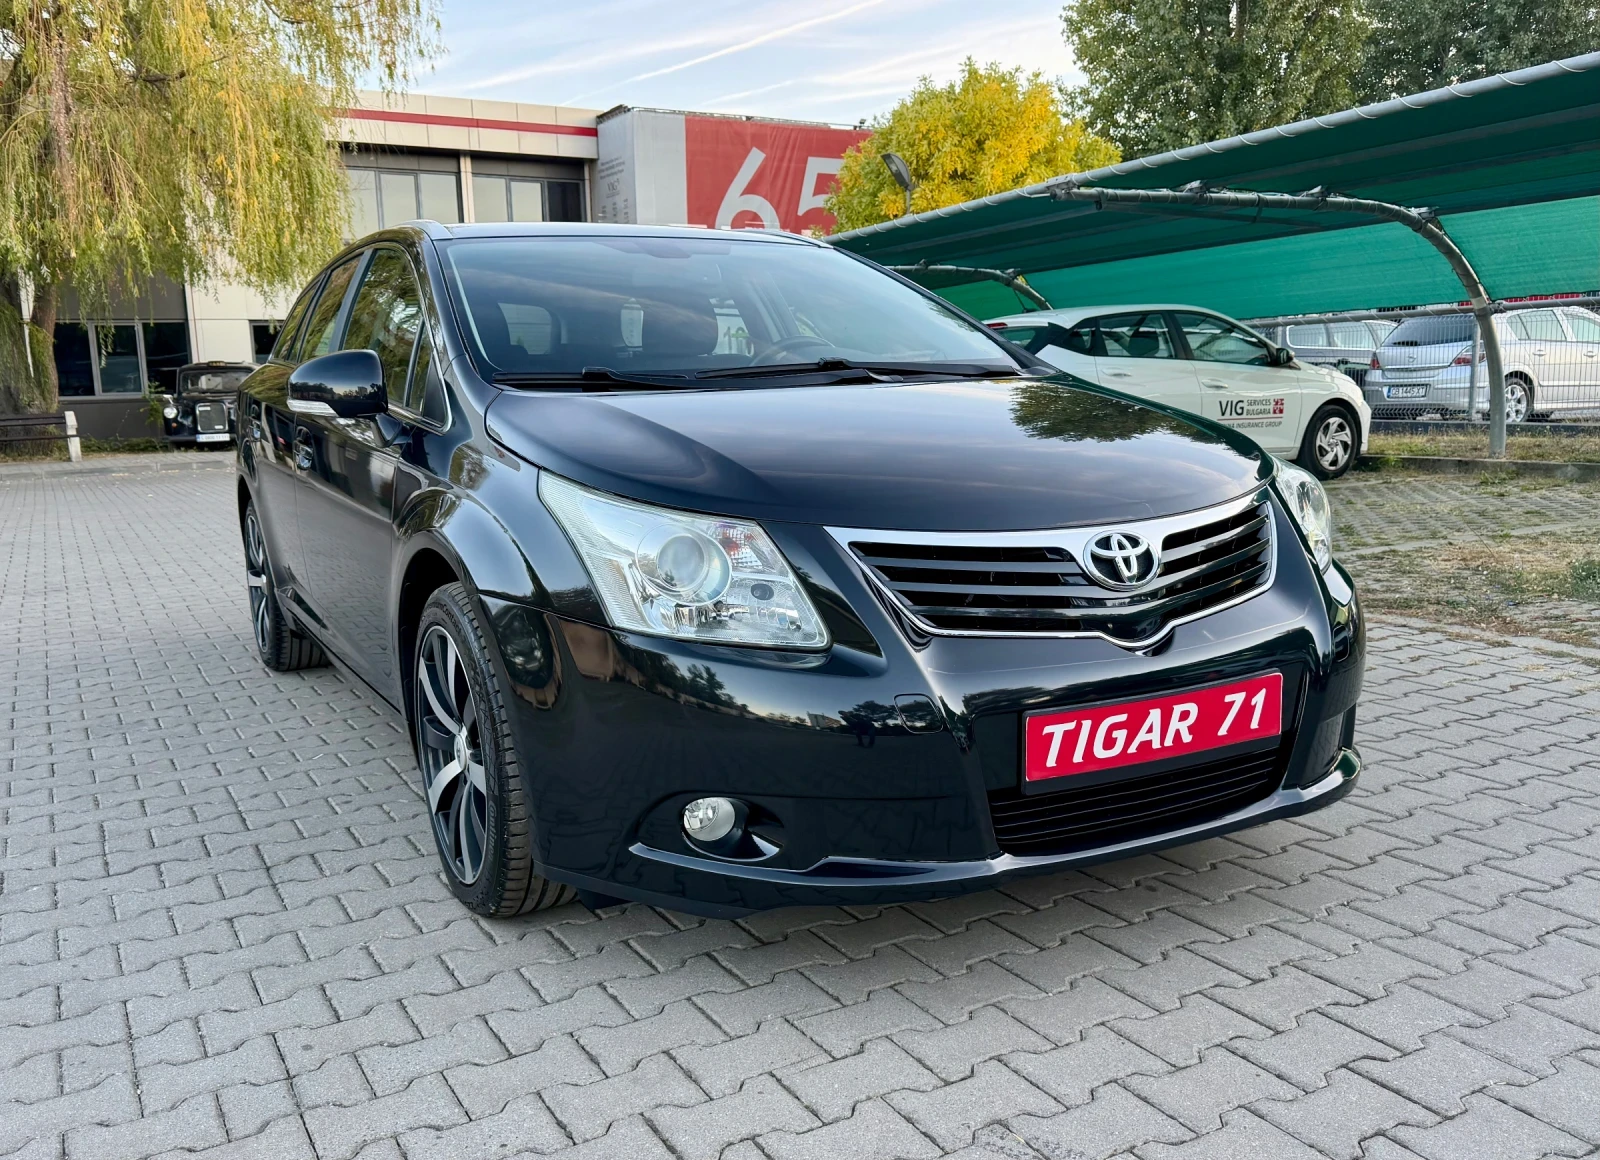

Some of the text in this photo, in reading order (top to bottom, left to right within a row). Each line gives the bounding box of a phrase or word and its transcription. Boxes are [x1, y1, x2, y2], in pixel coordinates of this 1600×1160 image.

[1246, 399, 1271, 407] SERVICES
[1219, 400, 1244, 416] VIG
[1245, 408, 1271, 416] BULGARIA
[1236, 421, 1264, 429] INSURANCE
[1265, 420, 1282, 428] GROUP
[1042, 688, 1267, 768] TIGAR 71
